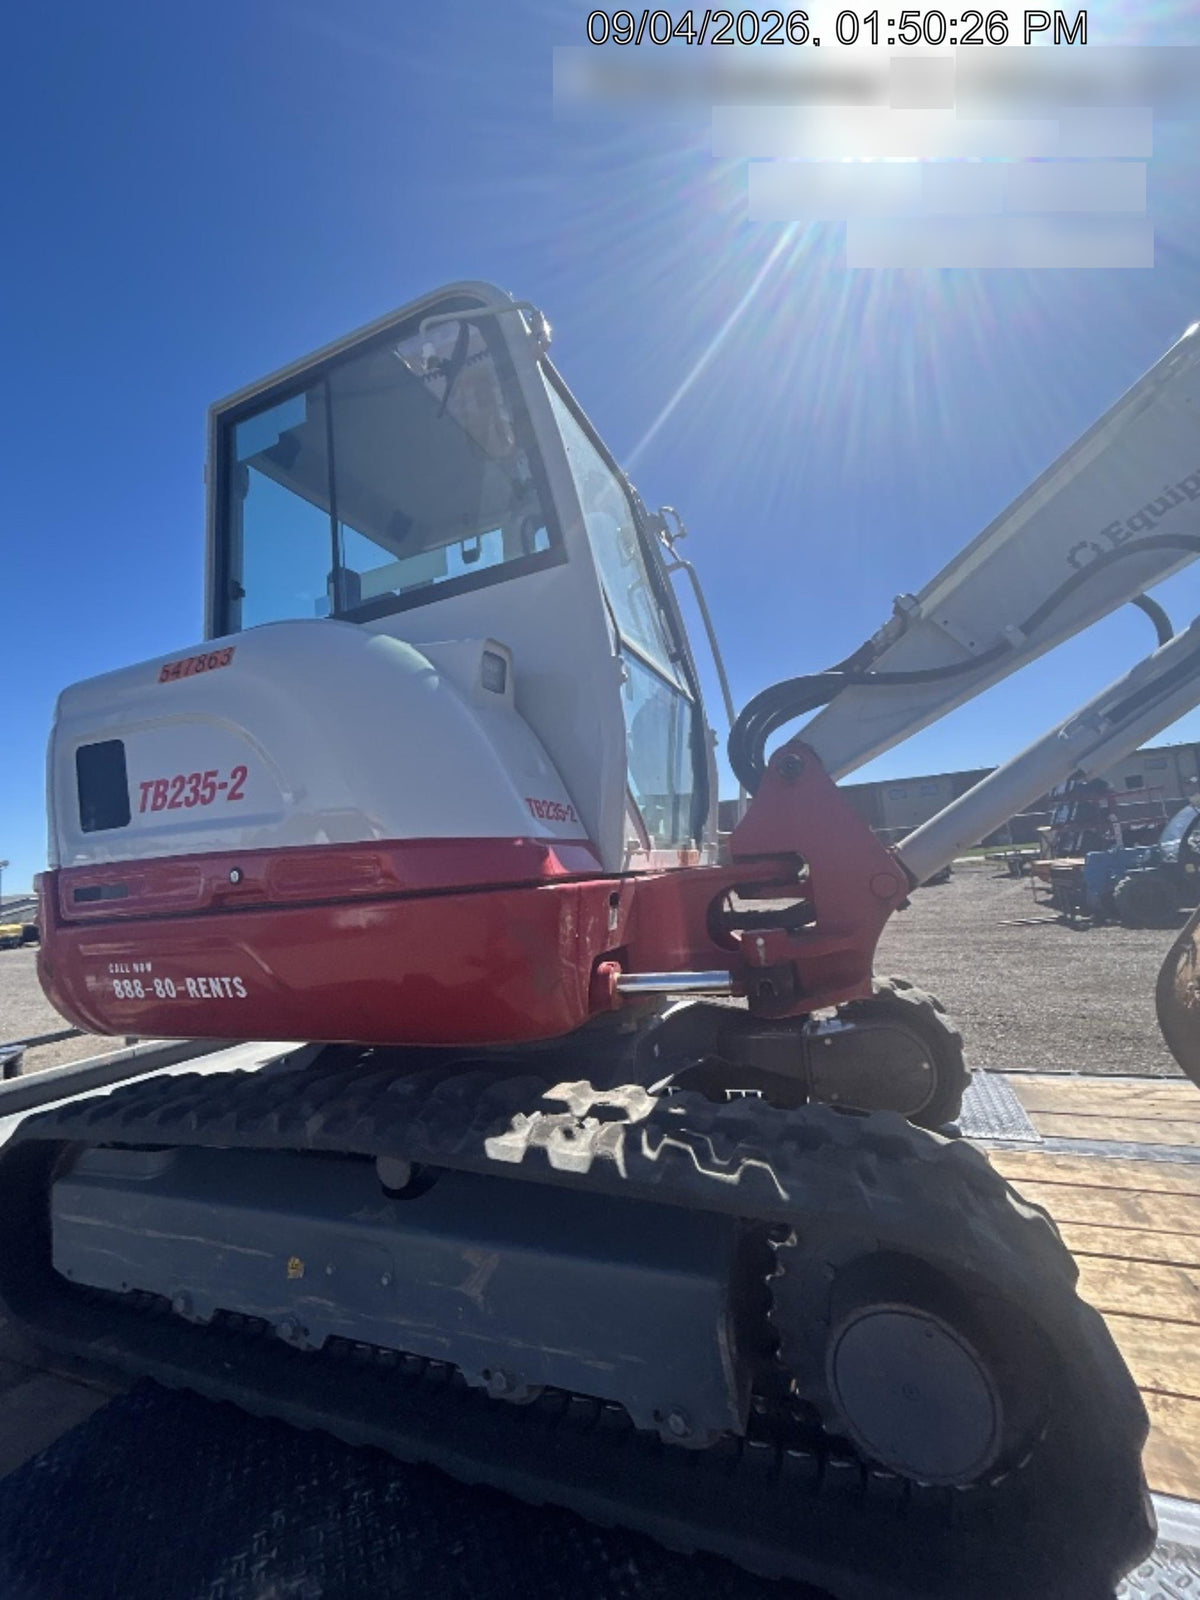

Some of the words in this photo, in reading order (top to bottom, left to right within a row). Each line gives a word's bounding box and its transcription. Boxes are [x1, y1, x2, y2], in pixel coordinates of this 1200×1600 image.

[159, 647, 235, 682] 547863
[139, 765, 248, 813] TB235-2
[525, 798, 578, 822] TB235-2
[108, 962, 131, 974] CALL
[133, 962, 152, 973] NOW
[112, 976, 248, 998] 888-80-RENTS
